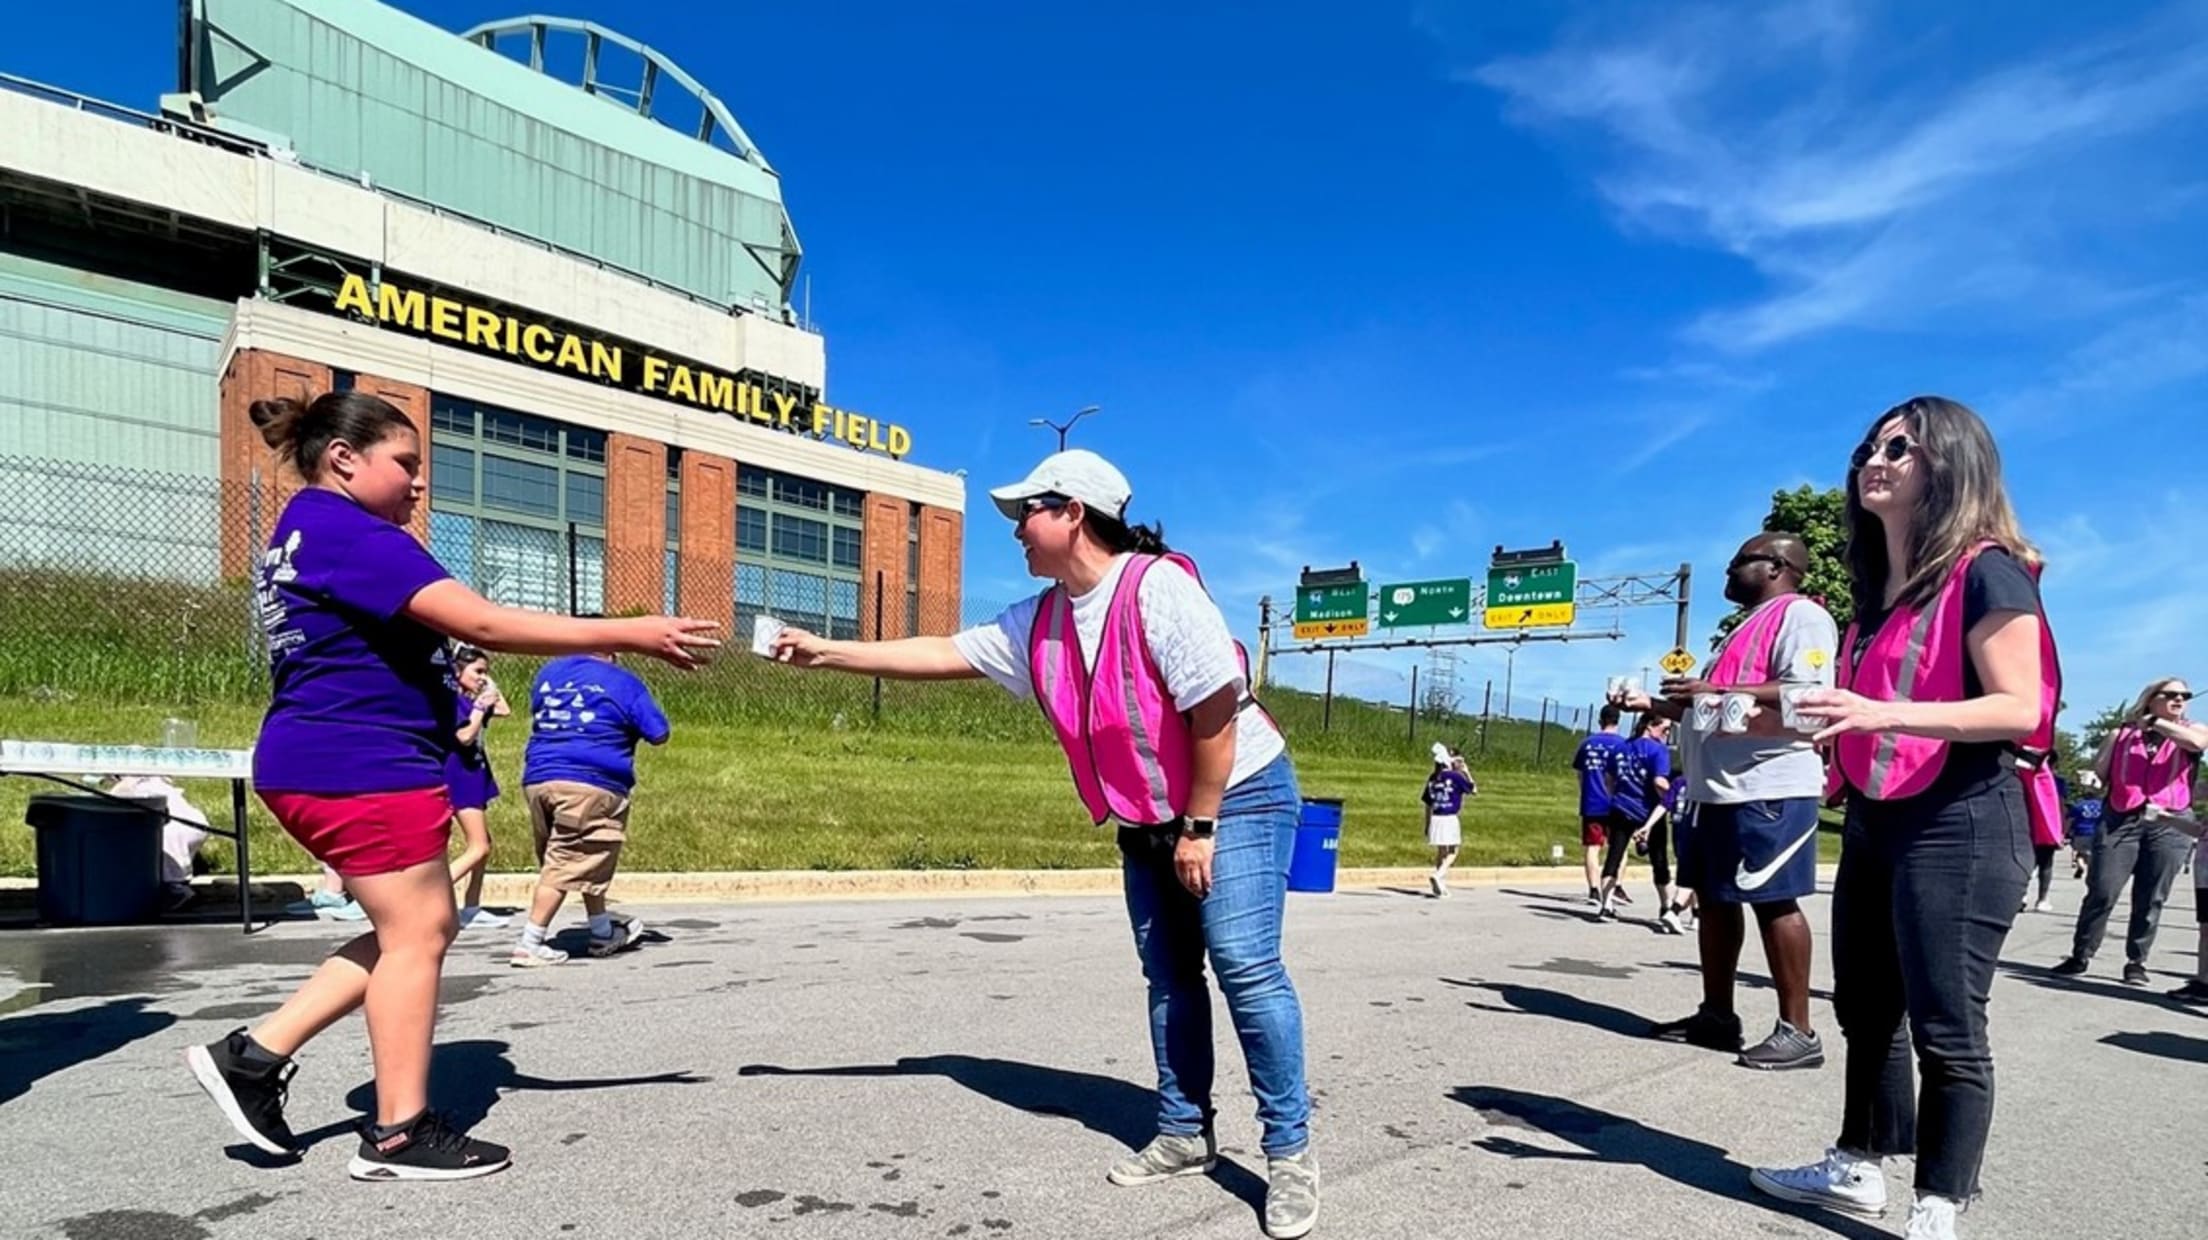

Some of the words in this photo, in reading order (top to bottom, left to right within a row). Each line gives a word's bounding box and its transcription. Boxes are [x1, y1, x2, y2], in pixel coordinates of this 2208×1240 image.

[334, 273, 622, 382] AMERICAN
[643, 356, 797, 426] FAMILY
[812, 403, 912, 456] FIELD
[1498, 591, 1562, 603] Downtown
[1310, 609, 1353, 619] Madison
[1301, 626, 1320, 634] EXIT
[1341, 623, 1365, 631] ONLY
